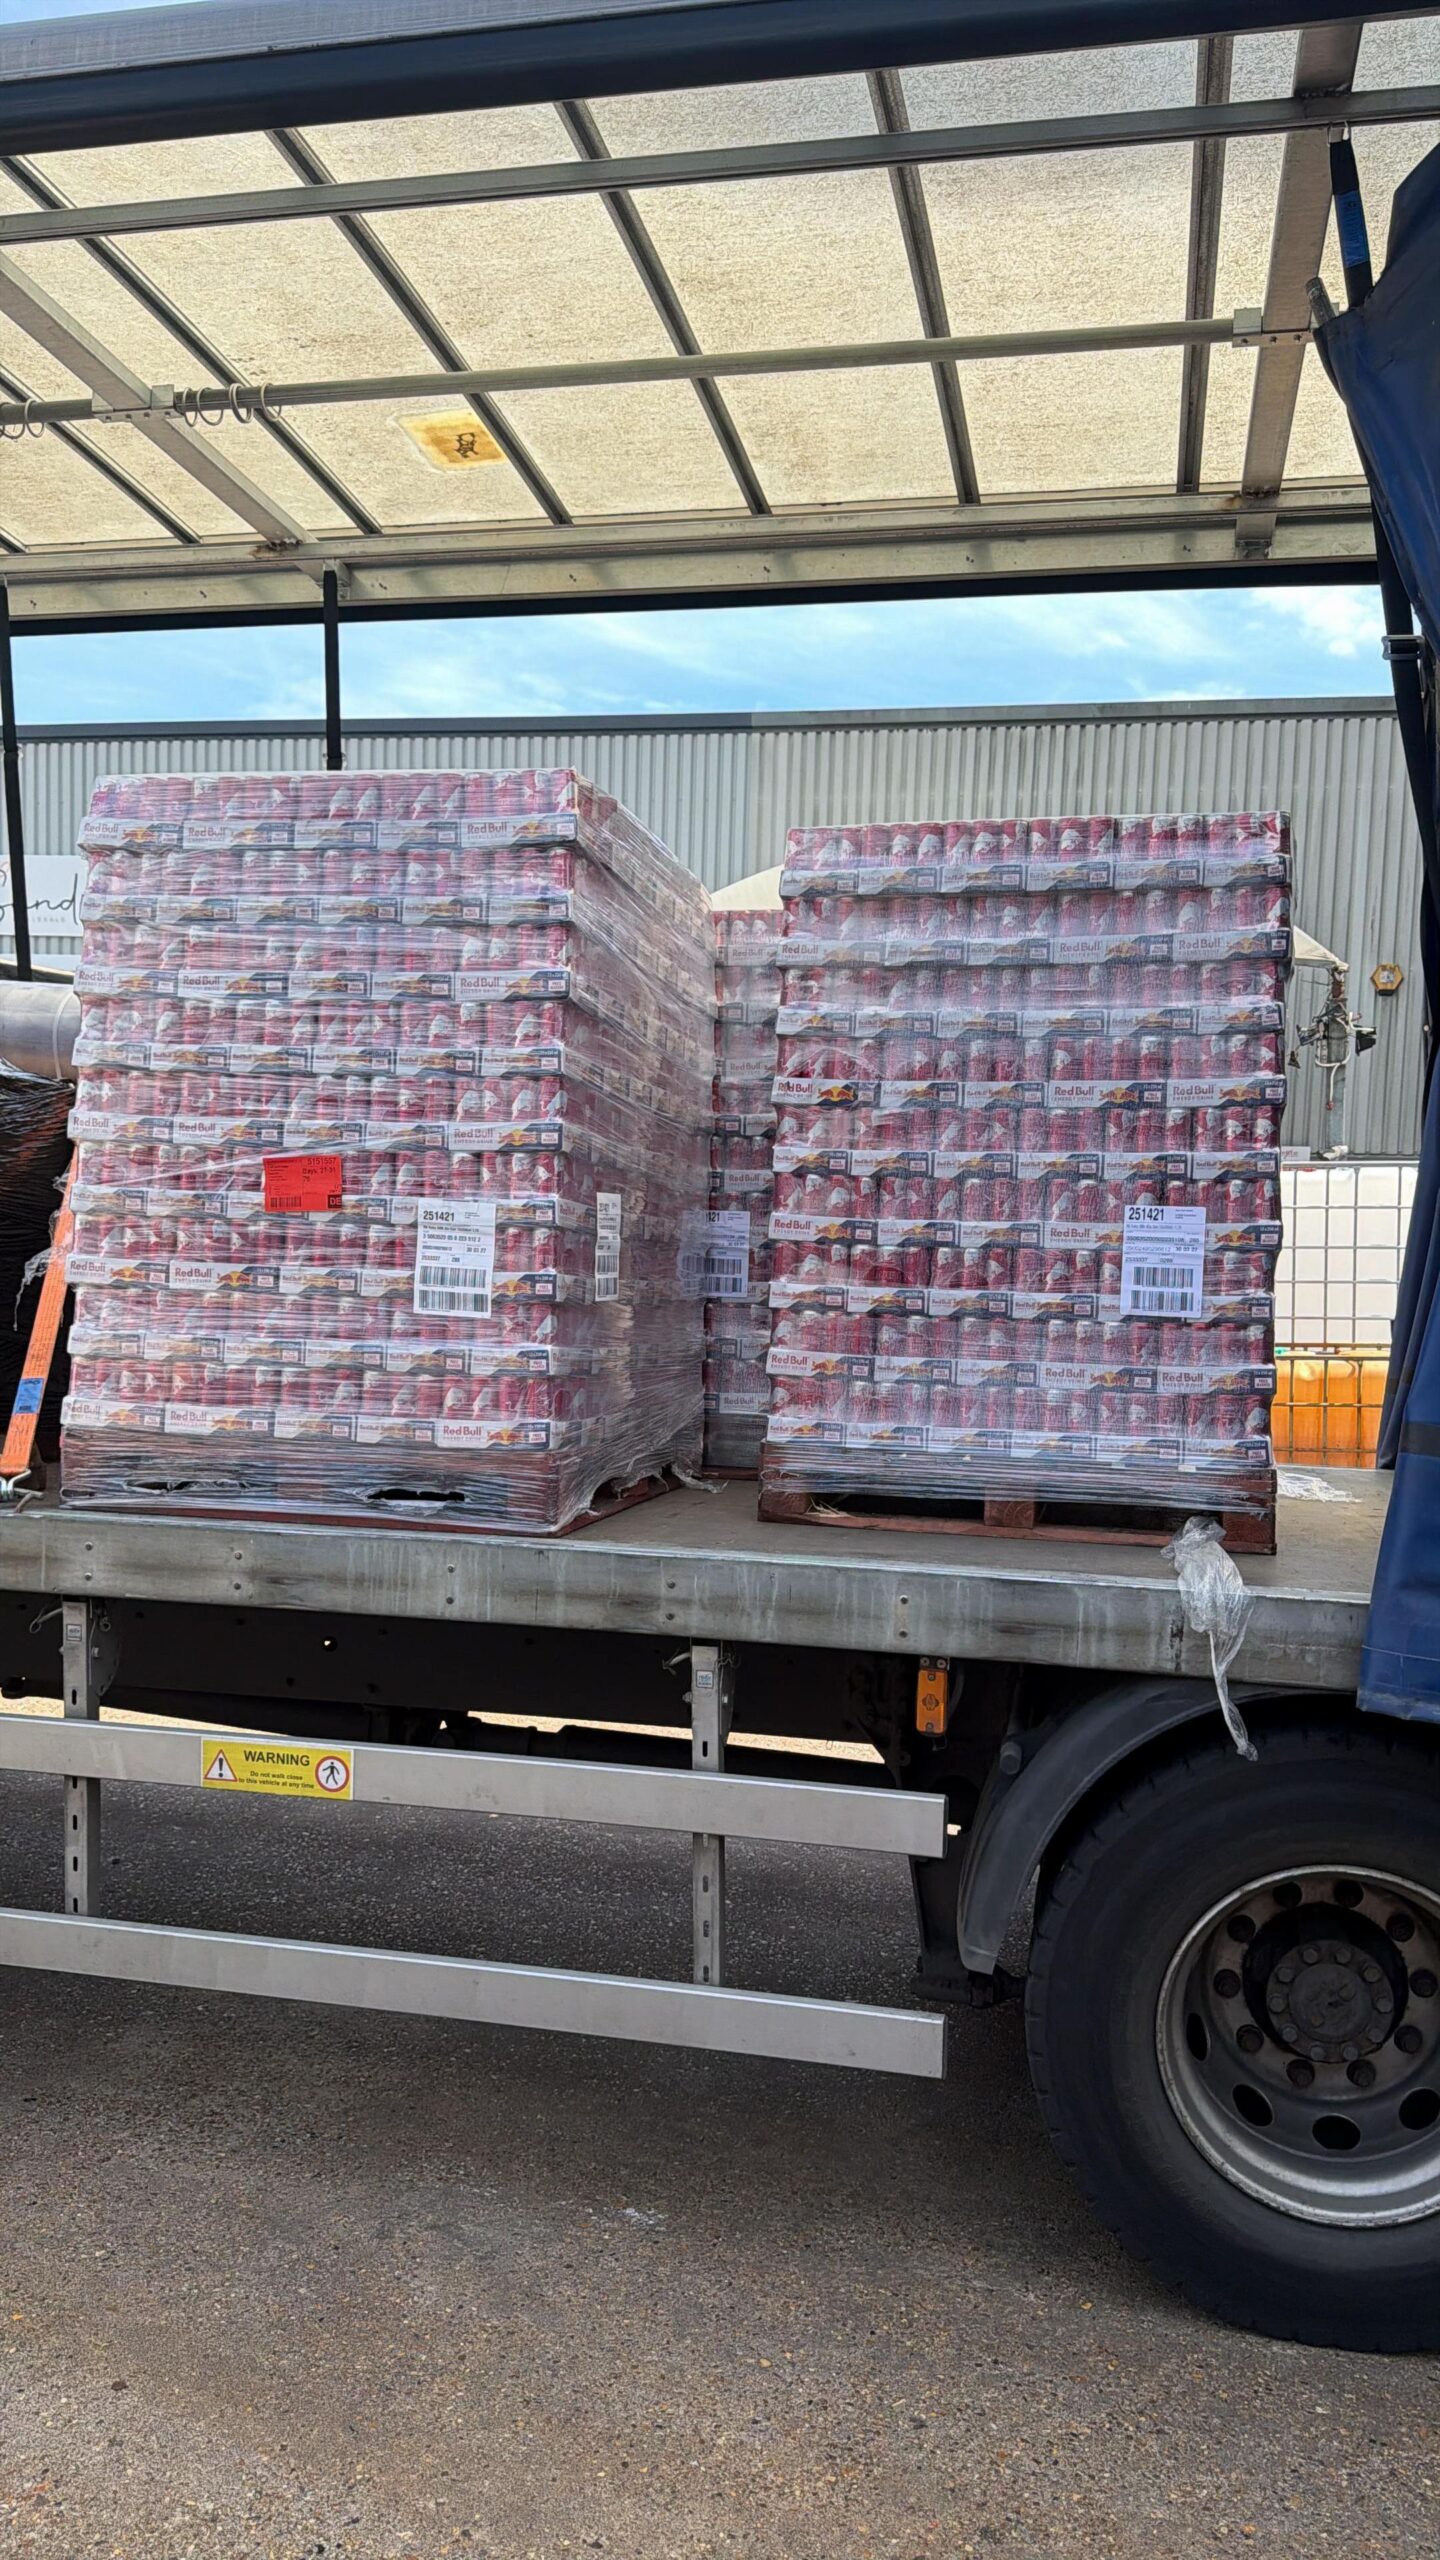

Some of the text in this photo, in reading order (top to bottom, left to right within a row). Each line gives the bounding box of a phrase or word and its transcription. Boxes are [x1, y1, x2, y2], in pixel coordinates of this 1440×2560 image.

[467, 821, 507, 834] Red Bull
[782, 944, 818, 954] Red Bull
[1060, 940, 1100, 952] Red Bull
[1179, 938, 1221, 949] Red Bull
[183, 976, 220, 985] Red Bull
[461, 976, 500, 987] Red Bull
[796, 1083, 813, 1093] Bull
[1055, 1086, 1094, 1096] Red Bull
[1173, 1084, 1214, 1096] Red Bull
[73, 1116, 109, 1128] Red Bull
[179, 1122, 216, 1132] Red Bull
[454, 1127, 493, 1138] Red Bull
[423, 1210, 455, 1222] 251421
[1128, 1207, 1164, 1221] 251421
[774, 1218, 811, 1230] Red Bull
[1050, 1228, 1090, 1238] Red Bull
[71, 1260, 106, 1272] Red Bull
[175, 1267, 212, 1278] Red Bull
[771, 1354, 808, 1365] Red Bull
[1045, 1367, 1085, 1378] Red Bull
[1162, 1372, 1203, 1382] Red Bull
[171, 1410, 207, 1421] Red Bull
[443, 1425, 482, 1436] Red Bull
[244, 1750, 310, 1767] WARNING
[246, 1777, 258, 1785] this
[259, 1779, 280, 1787] vehicle
[289, 1782, 300, 1790] any
[301, 1781, 315, 1789] time
